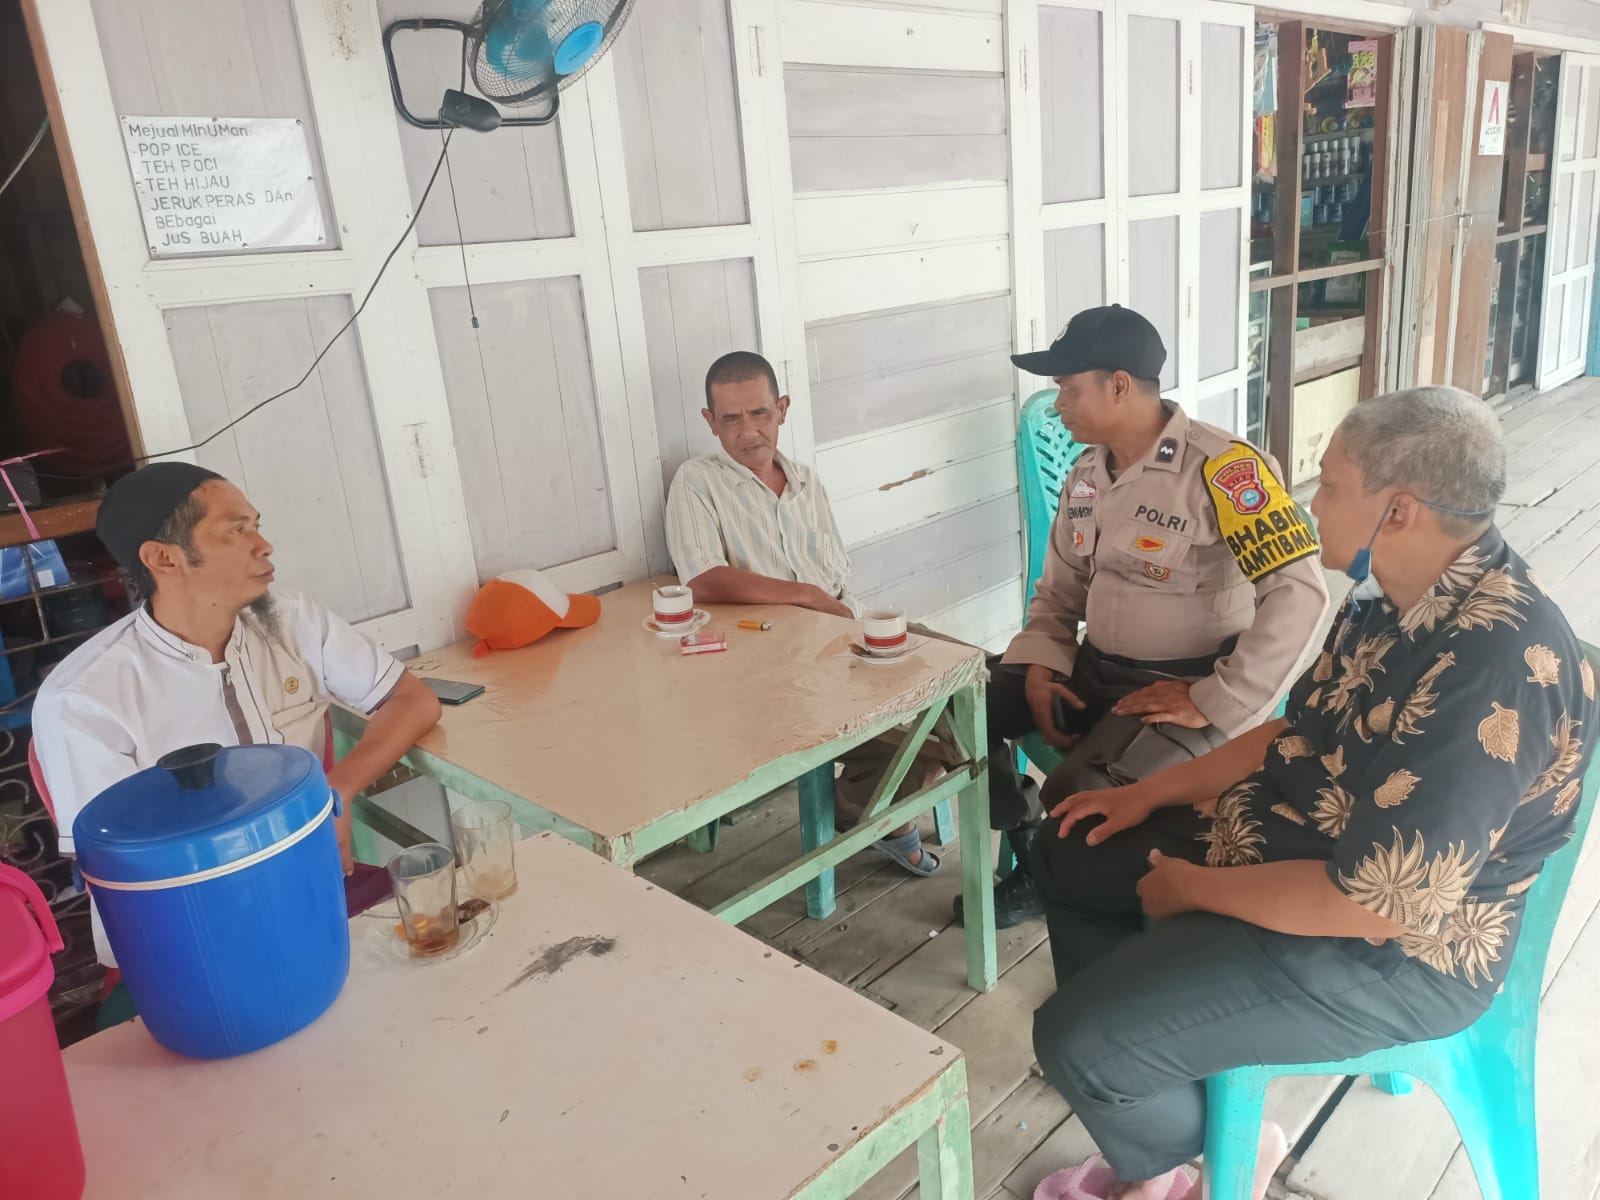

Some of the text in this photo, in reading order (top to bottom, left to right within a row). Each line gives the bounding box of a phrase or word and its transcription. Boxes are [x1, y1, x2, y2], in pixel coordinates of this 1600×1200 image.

[128, 123, 179, 139] Mejual
[138, 142, 202, 157] POP ICE
[142, 157, 218, 174] TEH POCI
[145, 175, 231, 192] TEH HIJAU
[150, 196, 203, 211] JERUK
[205, 192, 256, 208] PERAS
[199, 229, 243, 245] BUAH
[1134, 504, 1188, 532] POLRI
